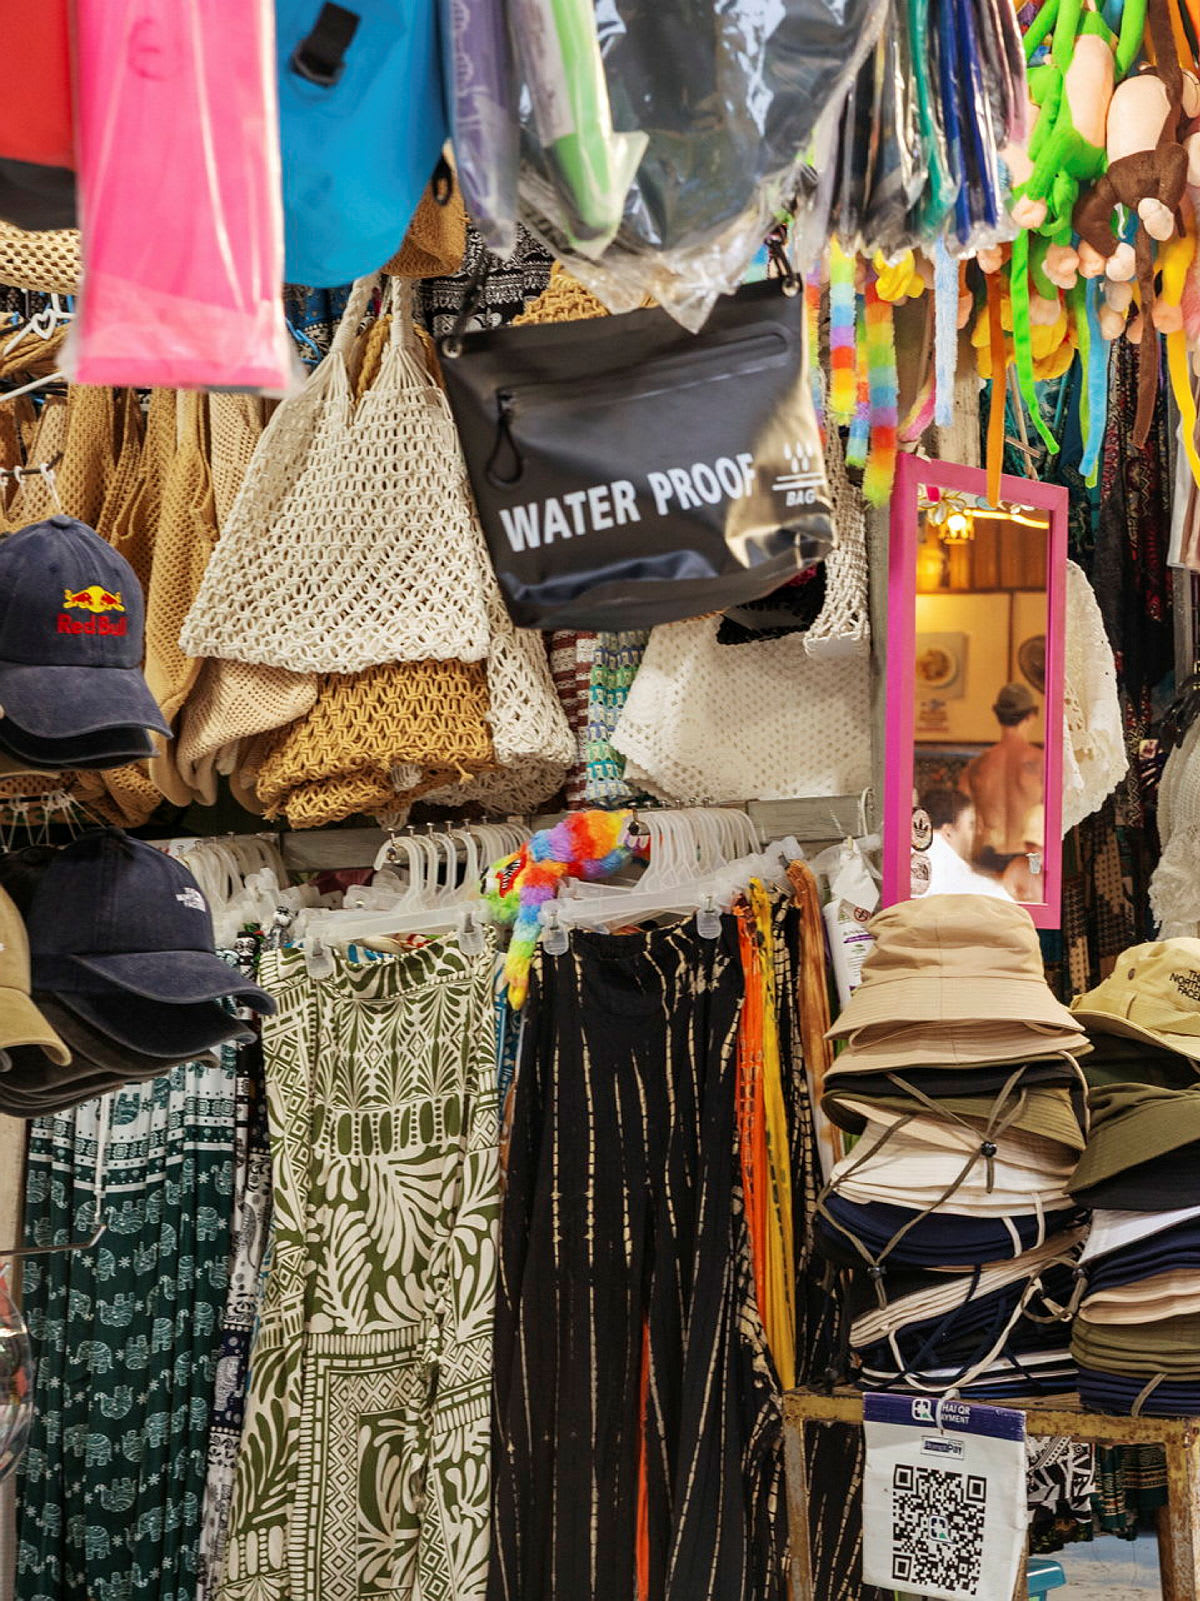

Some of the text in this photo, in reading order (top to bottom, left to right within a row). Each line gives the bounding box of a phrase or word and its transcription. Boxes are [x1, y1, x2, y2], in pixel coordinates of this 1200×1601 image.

[500, 453, 755, 552] WATER PROOF
[785, 489, 816, 507] BAG
[57, 614, 96, 634] Red
[1177, 986, 1200, 1001] FACE
[942, 1402, 970, 1415] HAI QR
